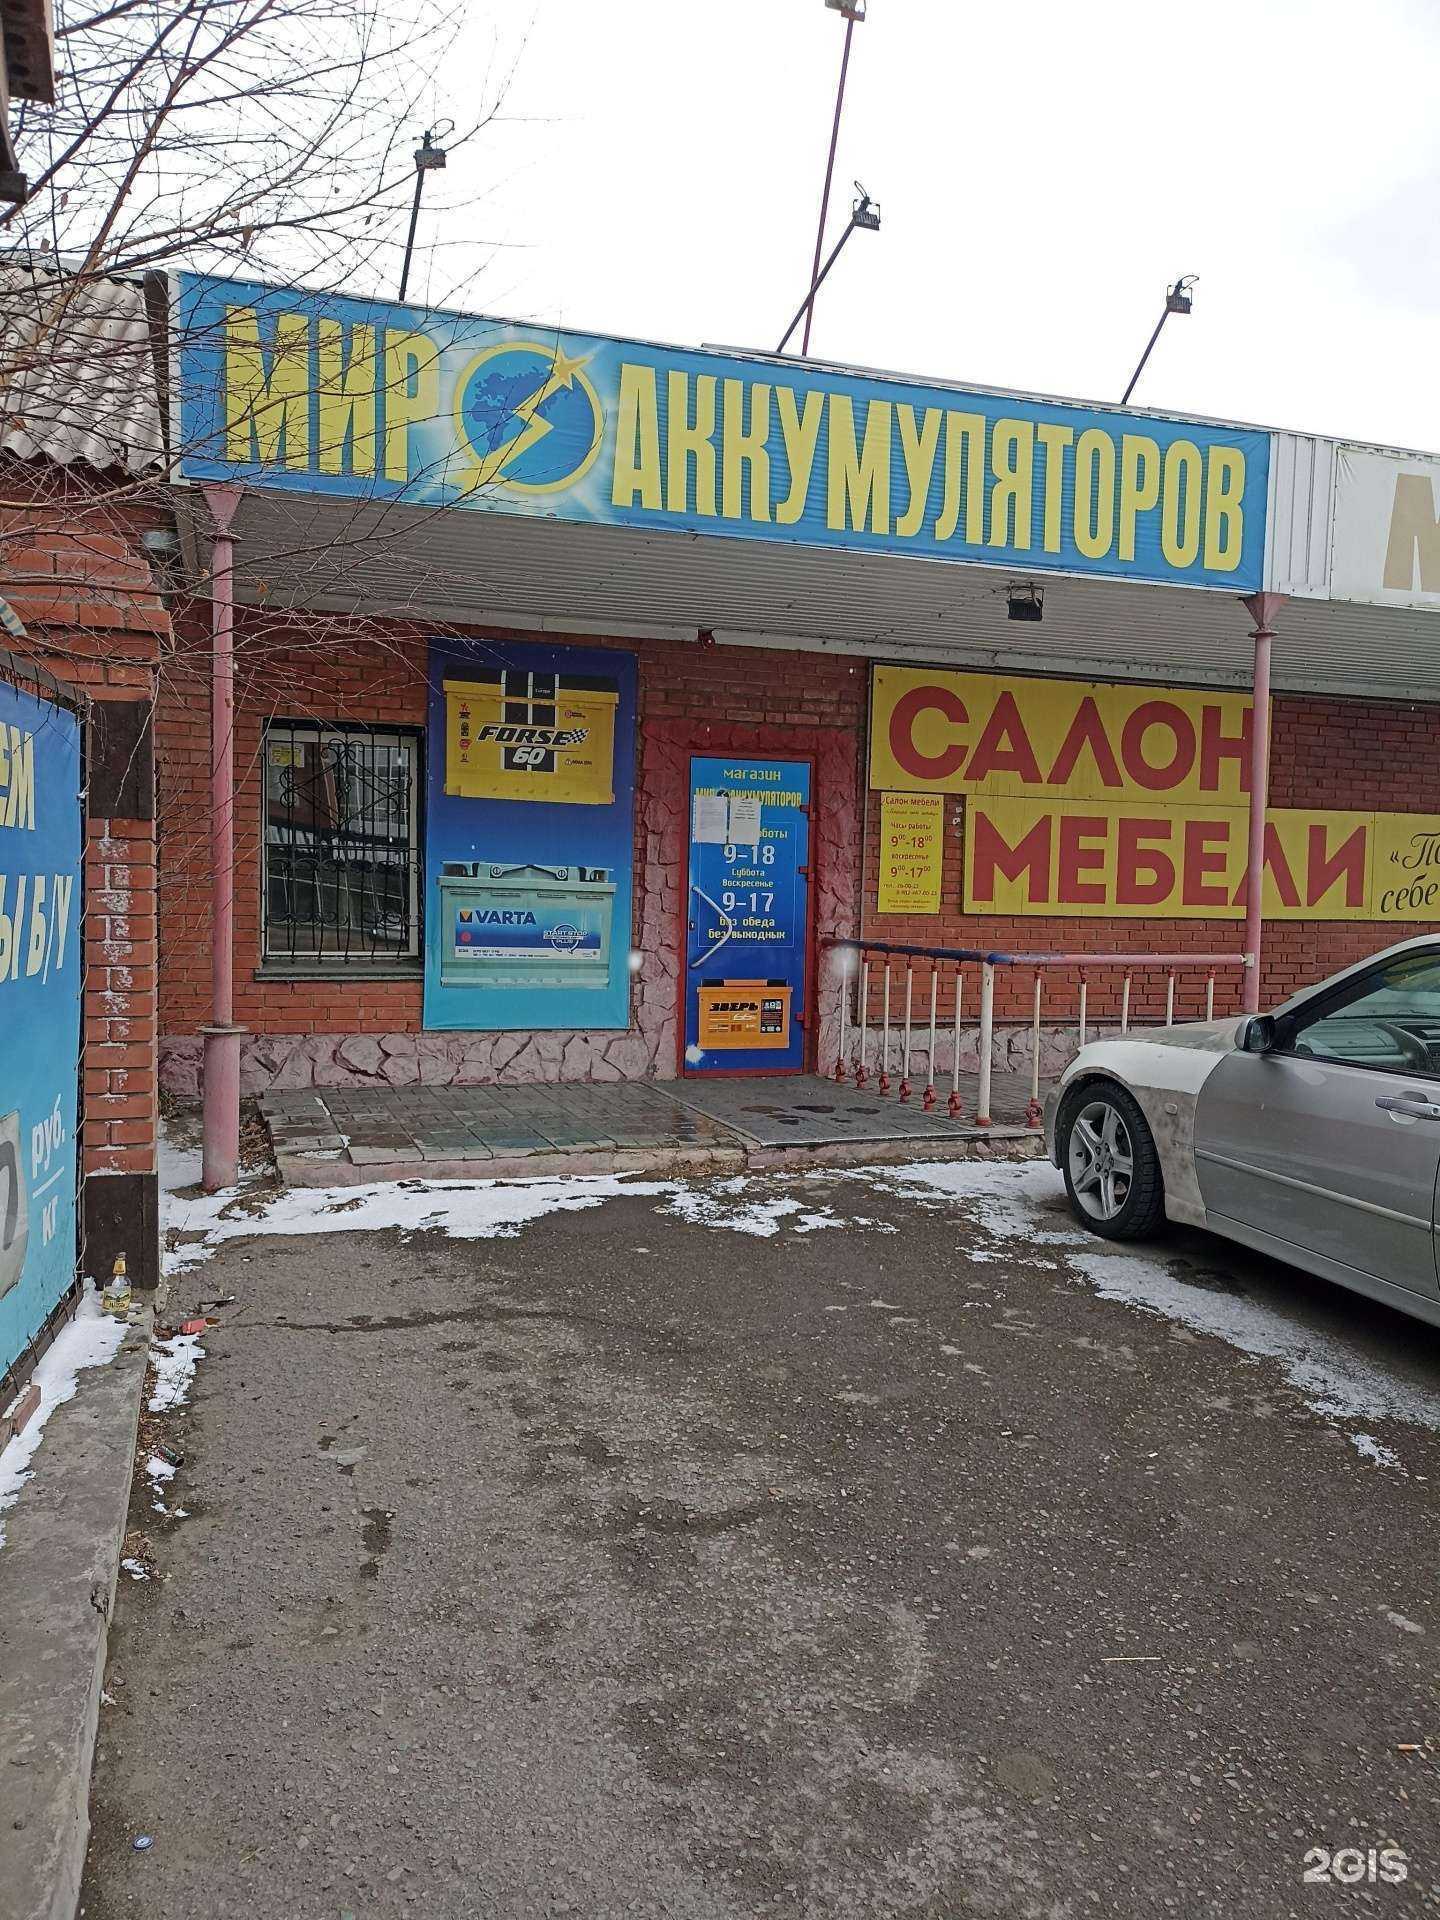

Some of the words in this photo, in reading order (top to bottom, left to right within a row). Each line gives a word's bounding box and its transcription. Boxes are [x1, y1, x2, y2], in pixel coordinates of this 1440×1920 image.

[225, 304, 439, 483] МИР
[611, 363, 1246, 573] АККУМУЛЯТОРОВ
[477, 725, 571, 746] FORSE
[889, 685, 1253, 793] САЛОН
[512, 746, 547, 765] 60
[723, 769, 781, 781] магазин
[972, 811, 1367, 908] МЕБЕЛИ
[731, 868, 765, 879] Суббота
[722, 879, 774, 890] Воскресенье
[1381, 872, 1438, 913] себе
[476, 909, 537, 925] VARTA
[743, 916, 775, 928] обеда
[32, 1093, 65, 1180] руб.
